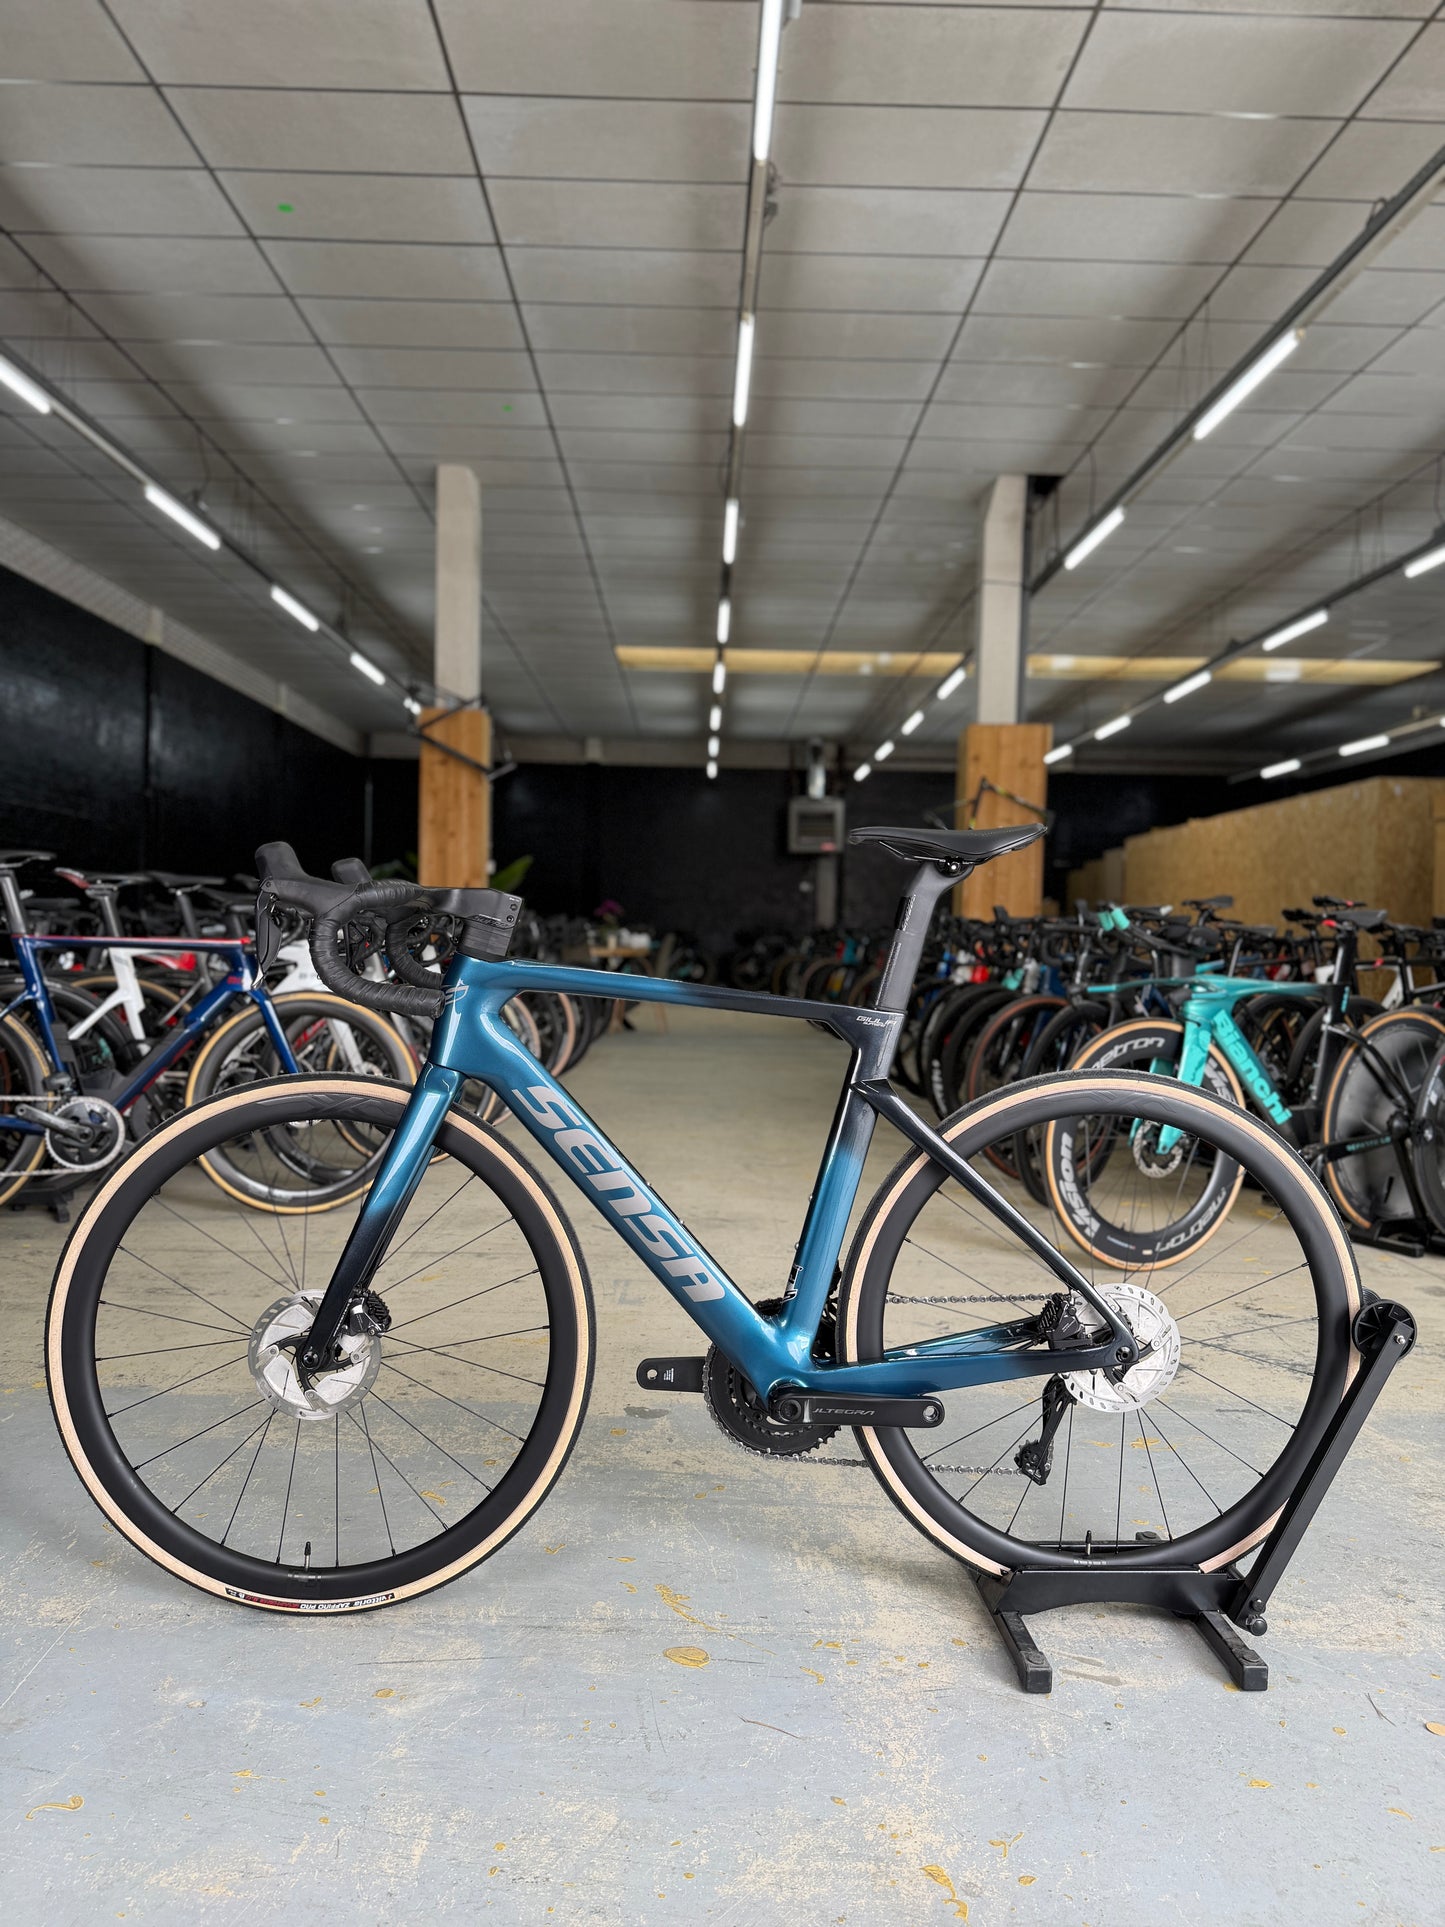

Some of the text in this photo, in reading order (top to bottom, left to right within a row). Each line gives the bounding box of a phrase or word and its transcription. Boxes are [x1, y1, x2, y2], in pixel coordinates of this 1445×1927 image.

[1213, 1010, 1292, 1125] Bianchi
[511, 1085, 726, 1302] SENSA
[353, 1595, 386, 1607] vittoria
